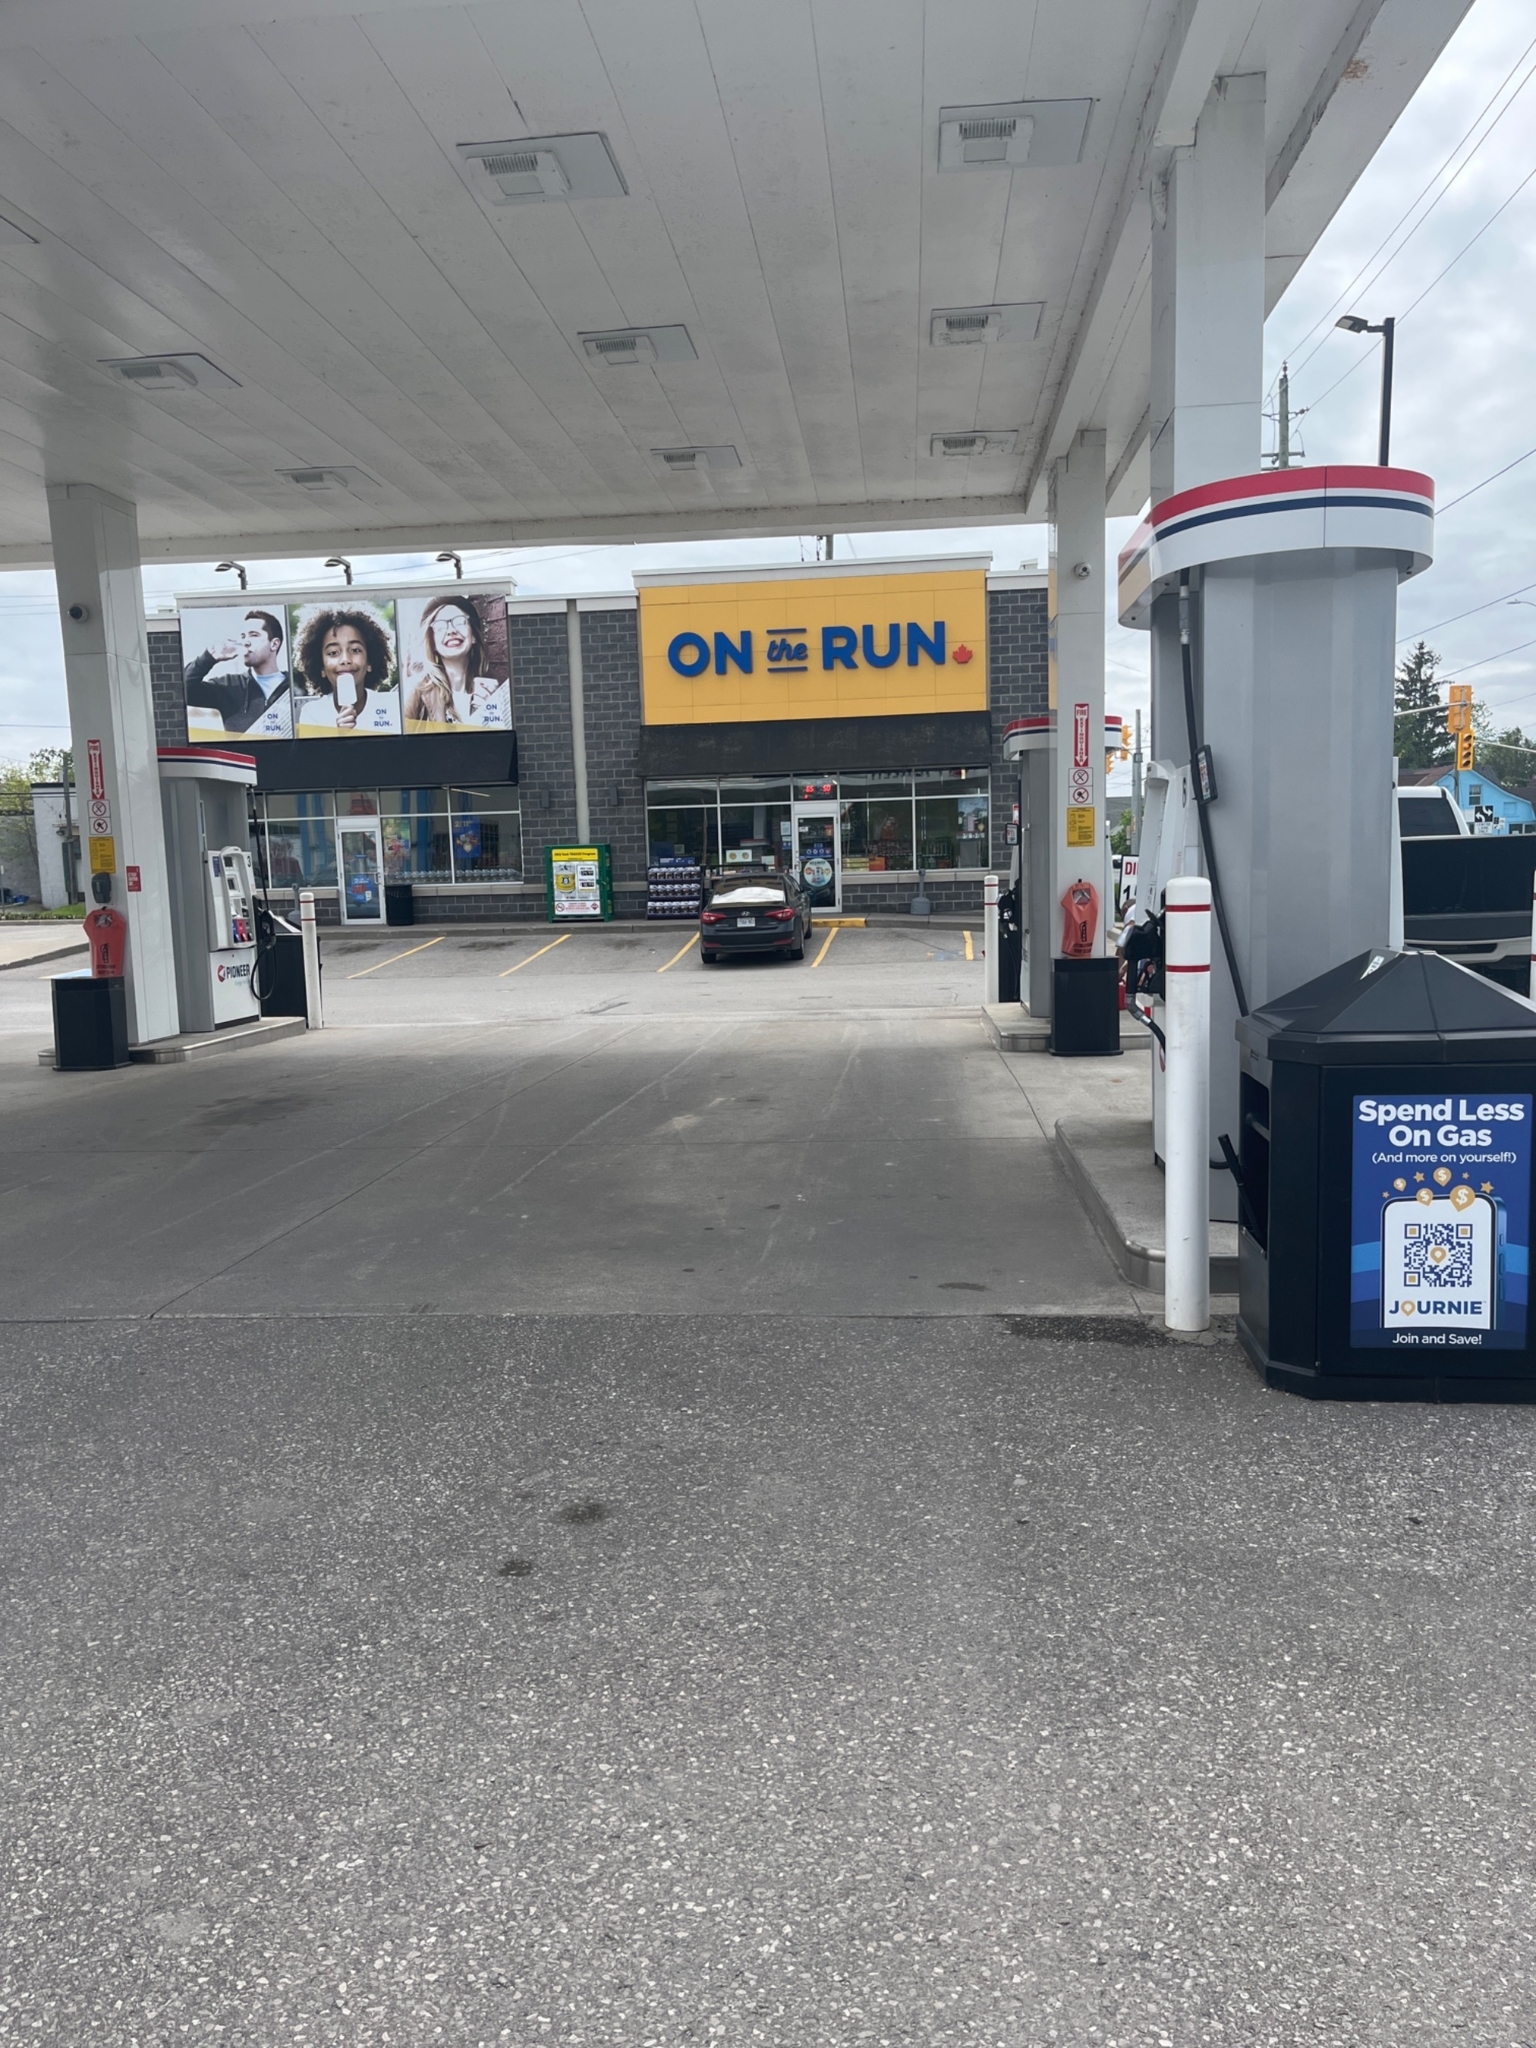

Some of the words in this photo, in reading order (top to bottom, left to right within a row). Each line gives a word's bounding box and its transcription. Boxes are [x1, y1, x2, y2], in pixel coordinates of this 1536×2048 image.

[668, 631, 753, 677] ON
[766, 638, 808, 662] the
[822, 621, 946, 671] RUN
[247, 856, 252, 867] 3
[1125, 862, 1138, 875] DI
[226, 964, 250, 979] PIONEER
[1358, 1098, 1452, 1126] Spend
[1459, 1099, 1525, 1122] Less
[1389, 1125, 1431, 1147] On
[1436, 1124, 1492, 1147] Gas
[1372, 1152, 1403, 1164] (And
[1405, 1154, 1438, 1163] more
[1440, 1154, 1456, 1163] on
[1459, 1152, 1517, 1165] yourself!)
[1392, 1333, 1419, 1344] Join
[1421, 1333, 1446, 1344] and
[1448, 1333, 1482, 1345] Save!
